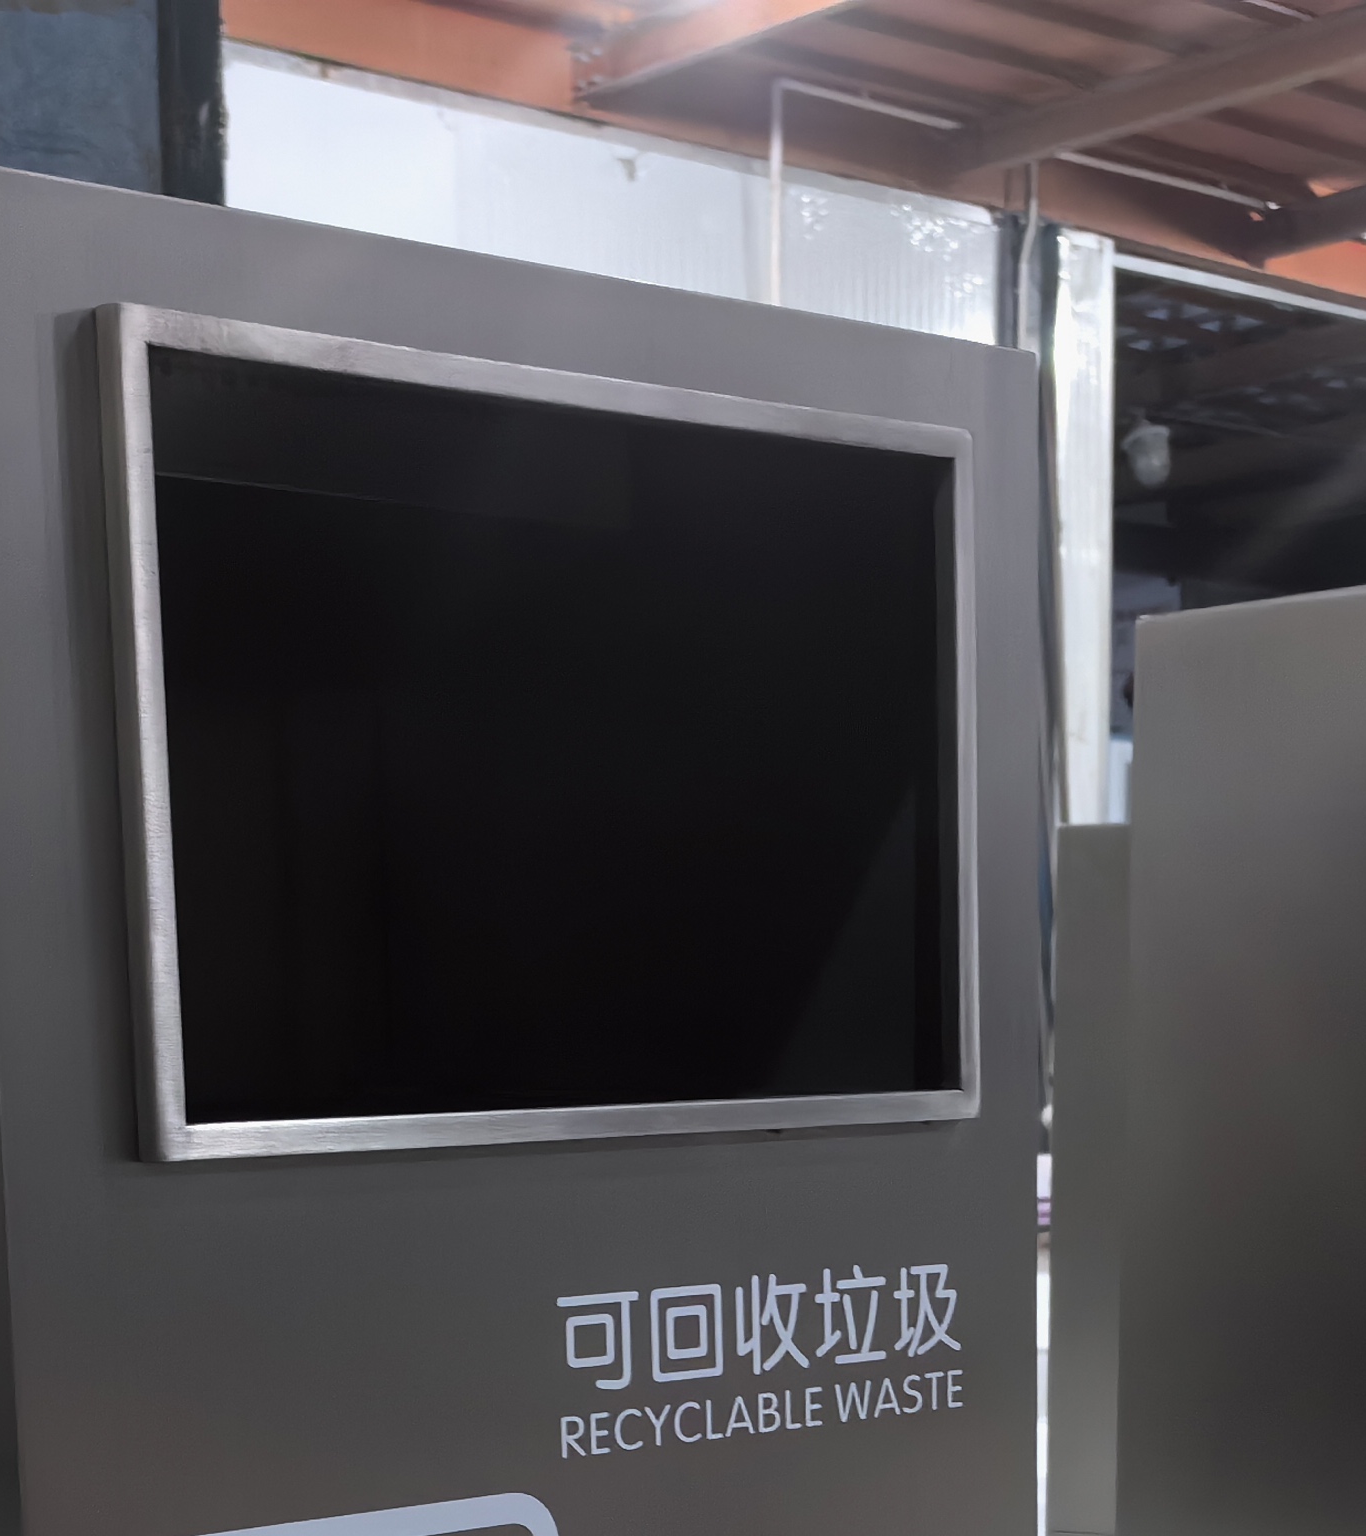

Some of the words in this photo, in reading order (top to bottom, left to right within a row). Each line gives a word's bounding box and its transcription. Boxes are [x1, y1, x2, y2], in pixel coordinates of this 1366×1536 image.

[557, 1264, 961, 1389] 可回收垃圾
[560, 1387, 823, 1458] RECYCLABLE
[835, 1370, 963, 1422] WASTE
